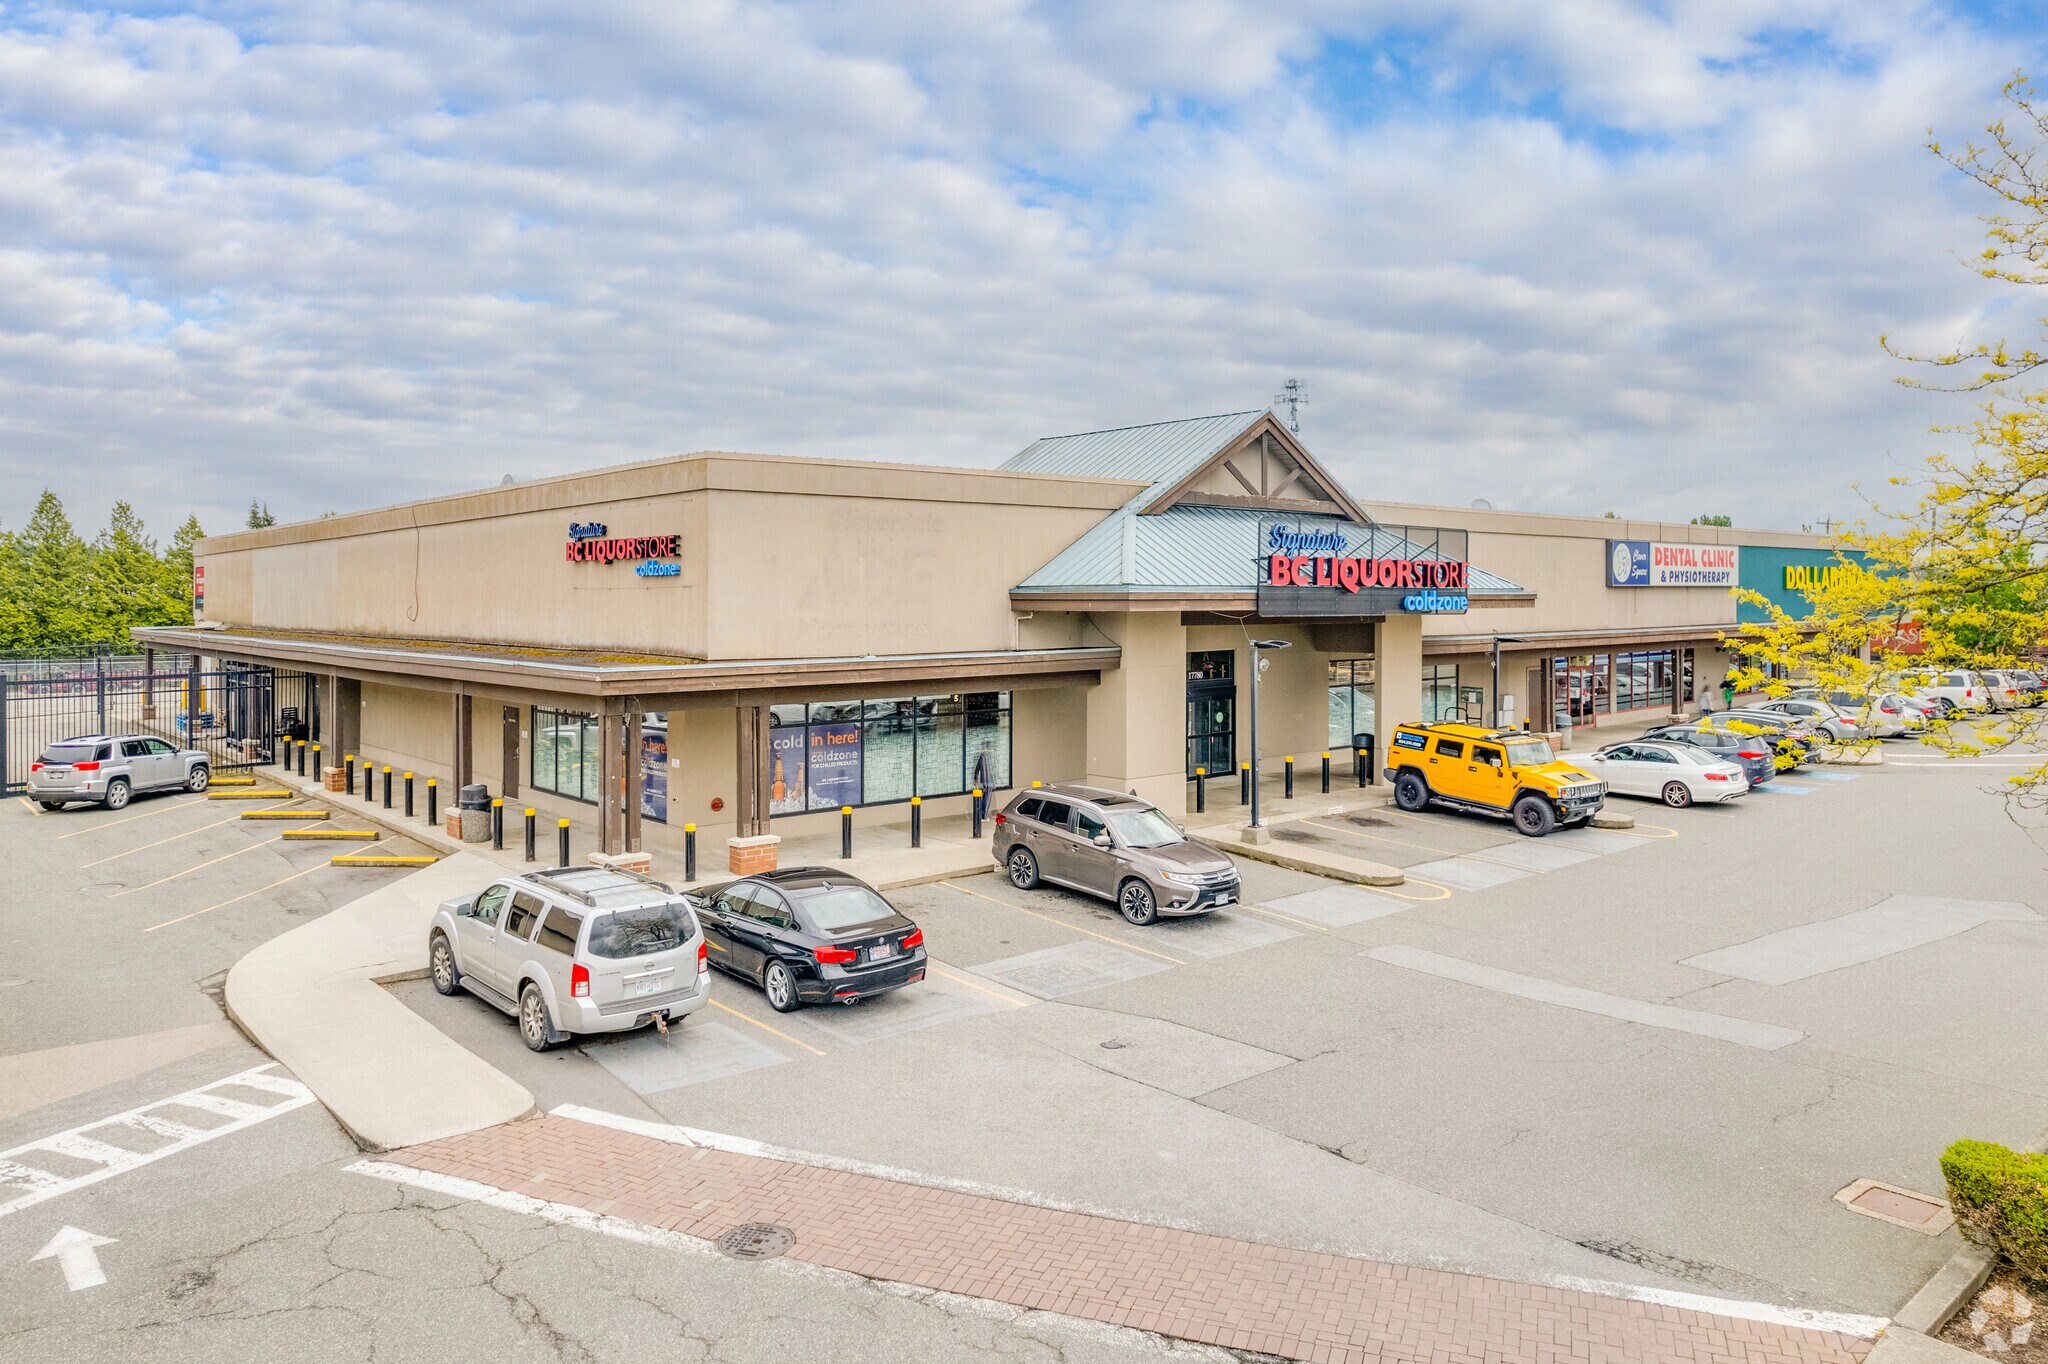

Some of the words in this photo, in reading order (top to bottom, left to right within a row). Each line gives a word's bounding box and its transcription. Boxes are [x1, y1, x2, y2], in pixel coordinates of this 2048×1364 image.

[568, 522, 607, 542] Signature
[1270, 523, 1348, 557] Signature
[566, 540, 583, 562] BC
[1654, 546, 1698, 567] DENTAL
[1701, 549, 1735, 569] CLINIC
[635, 560, 681, 577] coldzone
[1271, 555, 1309, 587] BC
[1660, 570, 1667, 583] &
[1669, 570, 1731, 584] PHYSIOTHERAPY
[1785, 565, 1864, 590] DOLLAR
[1405, 590, 1469, 611] coldzone
[773, 733, 804, 750] cold
[811, 732, 824, 747] in
[827, 729, 859, 746] here!
[811, 750, 858, 763] coldzone
